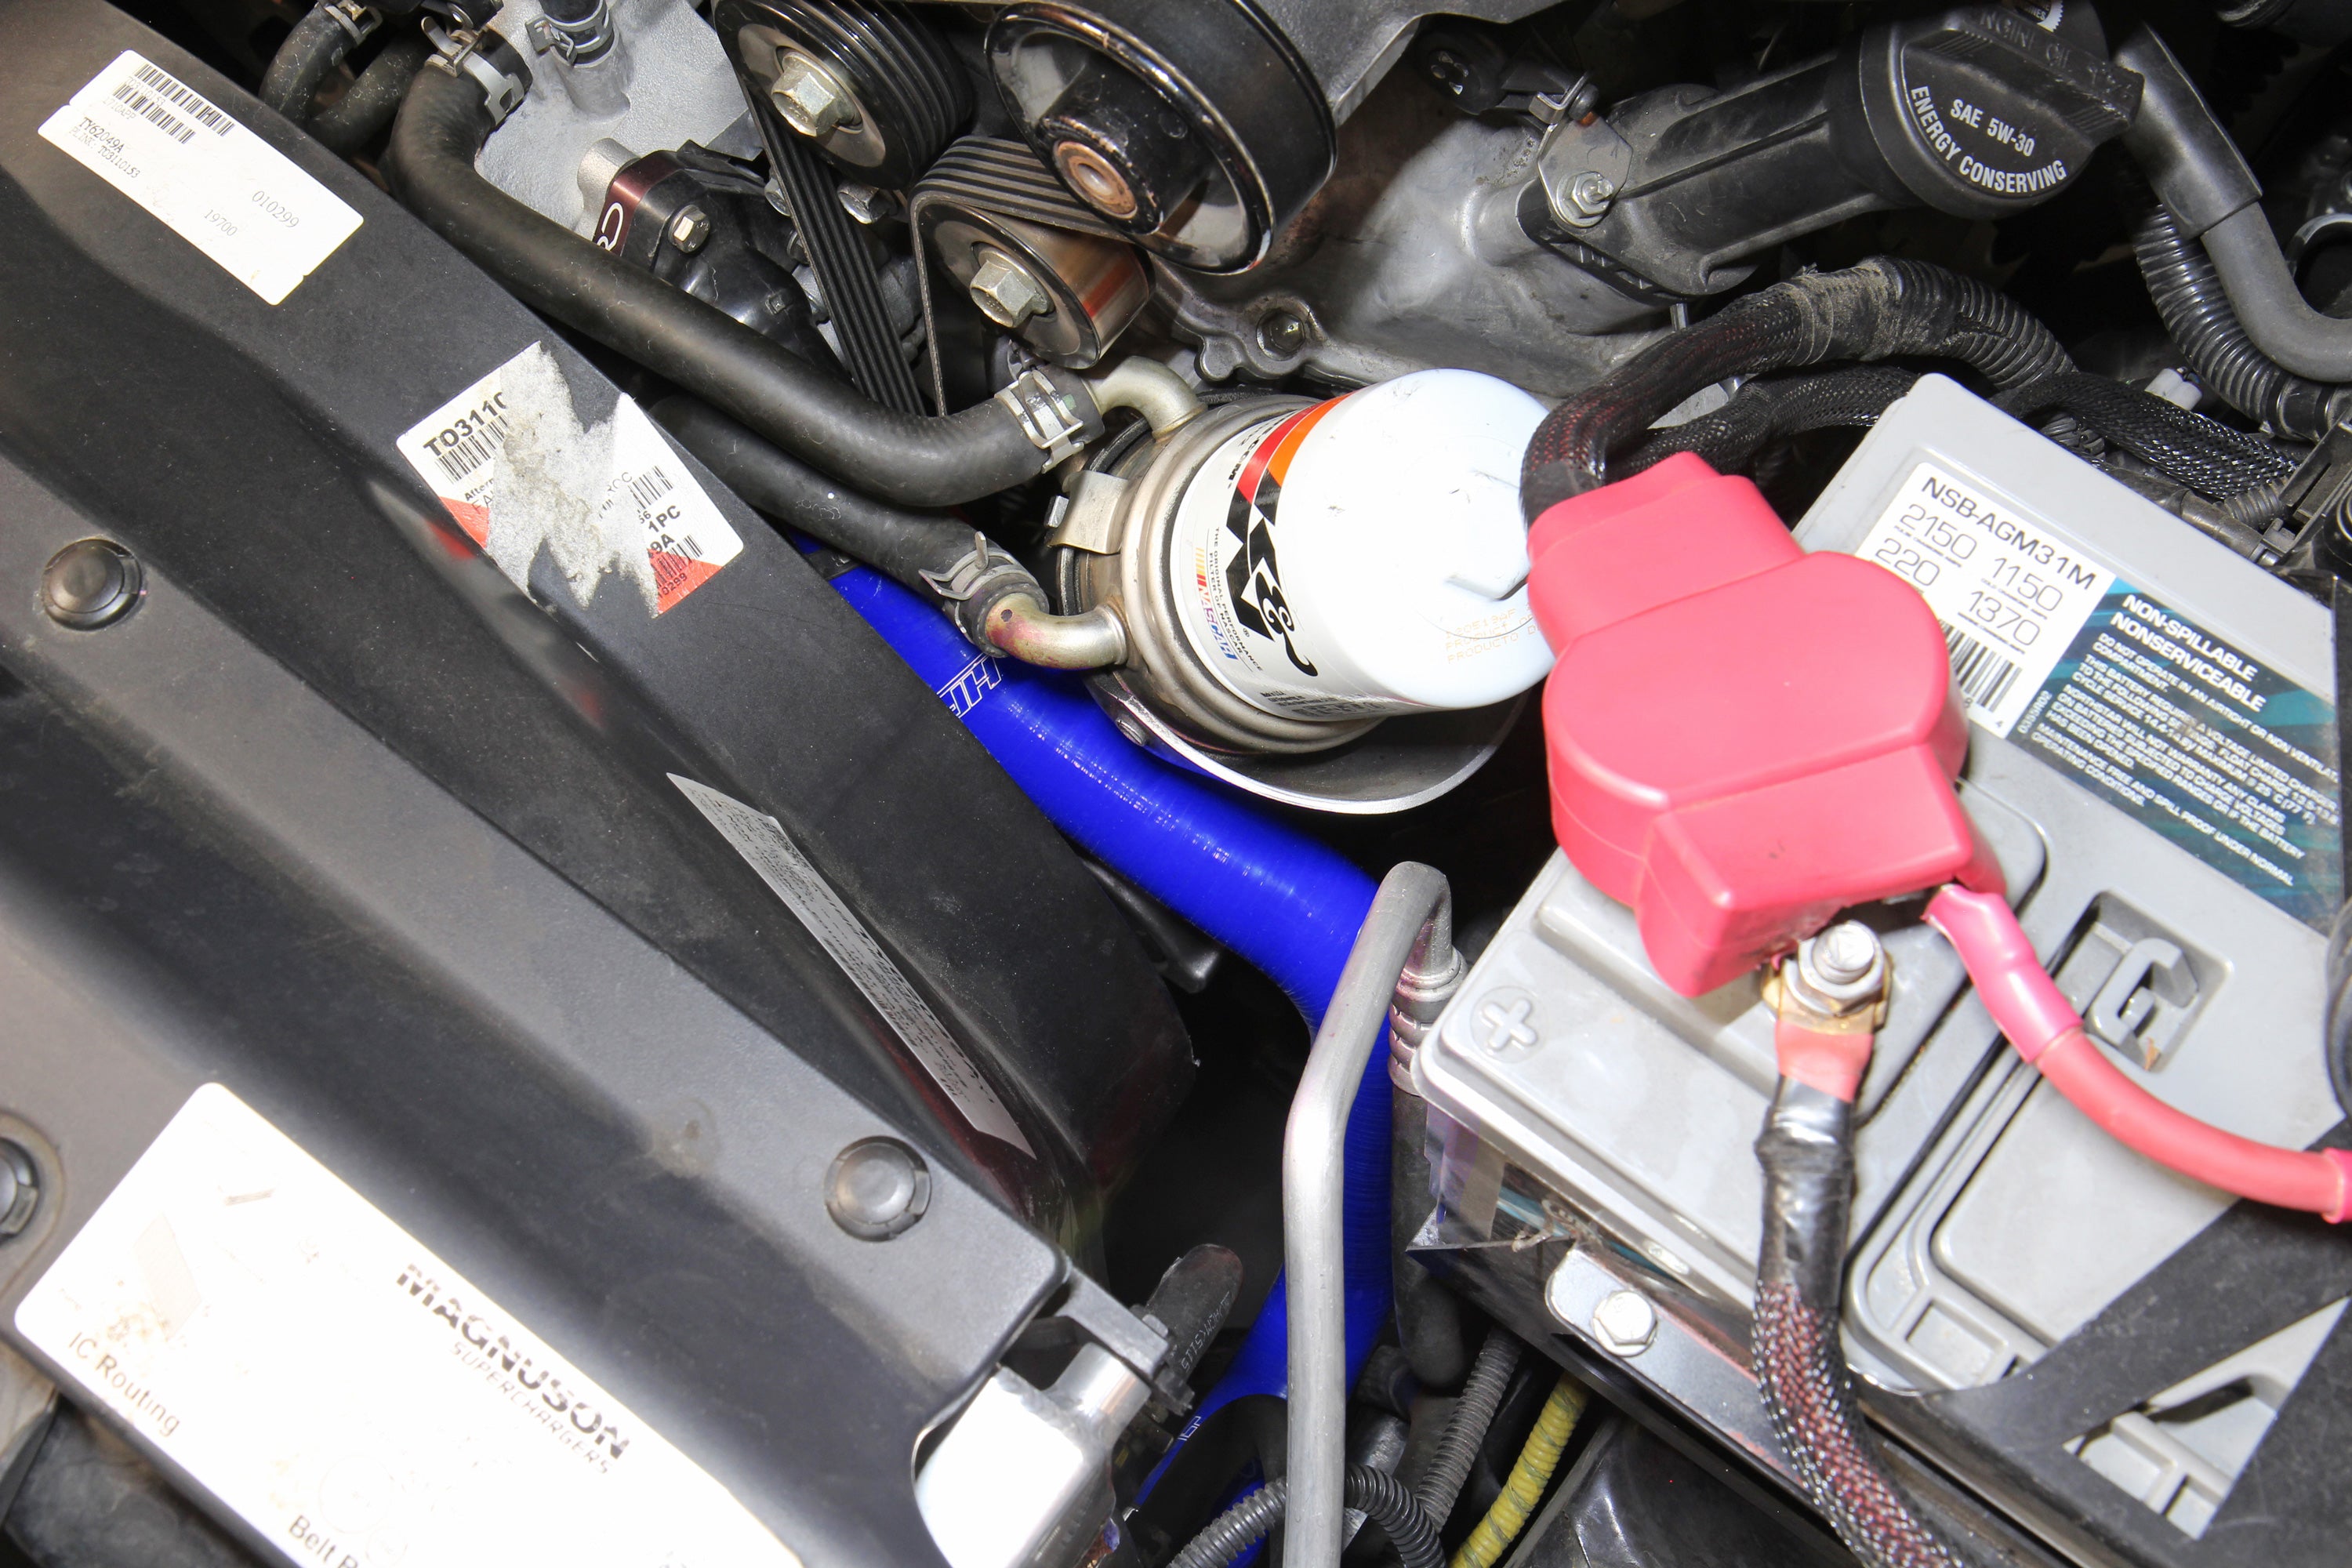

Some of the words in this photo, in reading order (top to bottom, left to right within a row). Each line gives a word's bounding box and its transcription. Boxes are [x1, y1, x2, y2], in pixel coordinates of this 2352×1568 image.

[79, 116, 125, 154] TY62049A
[1911, 85, 1962, 162] ENERGY
[1959, 156, 2067, 193] CONSERVING
[1951, 99, 1984, 129] SAE
[1987, 118, 2035, 157] 5W-30
[203, 209, 238, 237] 19700
[251, 190, 299, 228] 010299
[648, 505, 681, 532] 1PC
[1900, 501, 1978, 561] 2150
[1987, 554, 2064, 613] 1150
[1920, 474, 2096, 590] NSB-AGM31M
[1197, 579, 1239, 660] NASCAR
[1220, 612, 1243, 655] NASCAR
[1221, 603, 1263, 672] PERFORMANCE
[1875, 535, 1942, 588] 220
[1963, 587, 2042, 648] 1370
[2122, 593, 2257, 683] NON-SPILLABLE
[2092, 640, 2170, 693] COMPARTMENT.
[2098, 631, 2116, 648] DO
[2113, 641, 2137, 660] NOT
[2134, 653, 2180, 687] OPERATE
[2177, 680, 2192, 693] IN
[2189, 687, 2209, 703] AN
[2205, 697, 2252, 730] AIRTIGHT
[2249, 723, 2268, 739] OR
[2264, 732, 2292, 754] NON
[2110, 610, 2266, 713] NONSERVICEABLE
[2030, 730, 2087, 770] OPERATING
[2083, 763, 2147, 807] CONDITIONS.
[2045, 709, 2069, 728] HAS
[2066, 722, 2096, 745] BEEN
[2092, 738, 2136, 770] OPENED.
[2056, 691, 2075, 708] ON
[2073, 702, 2126, 739] BATTERIES
[2123, 732, 2182, 772] SUBJECTED
[2179, 766, 2197, 782] TO
[2193, 775, 2236, 806] CHARGE
[2233, 799, 2286, 836] VOLTAGES
[2063, 684, 2123, 724] NORTHSTAR
[2121, 718, 2147, 739] WILL
[2144, 733, 2169, 753] NOT
[2166, 746, 2226, 787] WARRANTY
[2222, 780, 2249, 801] ANY
[2245, 794, 2286, 824] CLAIMS
[2071, 670, 2105, 695] CYCLE
[2101, 688, 2145, 720] SERVICE
[2193, 745, 2249, 783] MAXIMUM
[2254, 782, 2273, 797] 25
[2077, 662, 2095, 677] TO
[2092, 670, 2114, 688] THE
[2111, 683, 2169, 723] FOLLOWING
[2217, 746, 2252, 773] FLOAT
[2248, 765, 2292, 797] CHARGE
[2083, 653, 2108, 673] THIS
[2105, 666, 2151, 699] BATTERY
[2195, 721, 2208, 734] A
[2205, 727, 2251, 760] VOLTAGE
[2248, 753, 2290, 784] LIMITED
[2035, 722, 2109, 771] MAINTENANCE
[2105, 764, 2134, 786] FREE
[2130, 779, 2156, 800] AND
[2152, 793, 2183, 816] SPILL
[2180, 810, 2217, 837] PROOF
[2214, 830, 2252, 858] UNDER
[2249, 851, 2296, 886] NORMAL
[2049, 700, 2107, 739] EXCEEDING
[2104, 733, 2127, 752] THE
[2123, 745, 2175, 781] SPECIFIED
[2171, 774, 2216, 805] RANGES
[2212, 798, 2230, 815] OR
[2227, 808, 2241, 822] IF
[2238, 814, 2261, 833] THE
[2258, 826, 2306, 860] BATTERY
[68, 1331, 97, 1359] IC
[95, 1353, 181, 1438] Routing
[396, 1262, 630, 1460] MAGNUSON
[450, 1341, 612, 1475] SUPERCHARGERS
[289, 1514, 336, 1563] Belt
